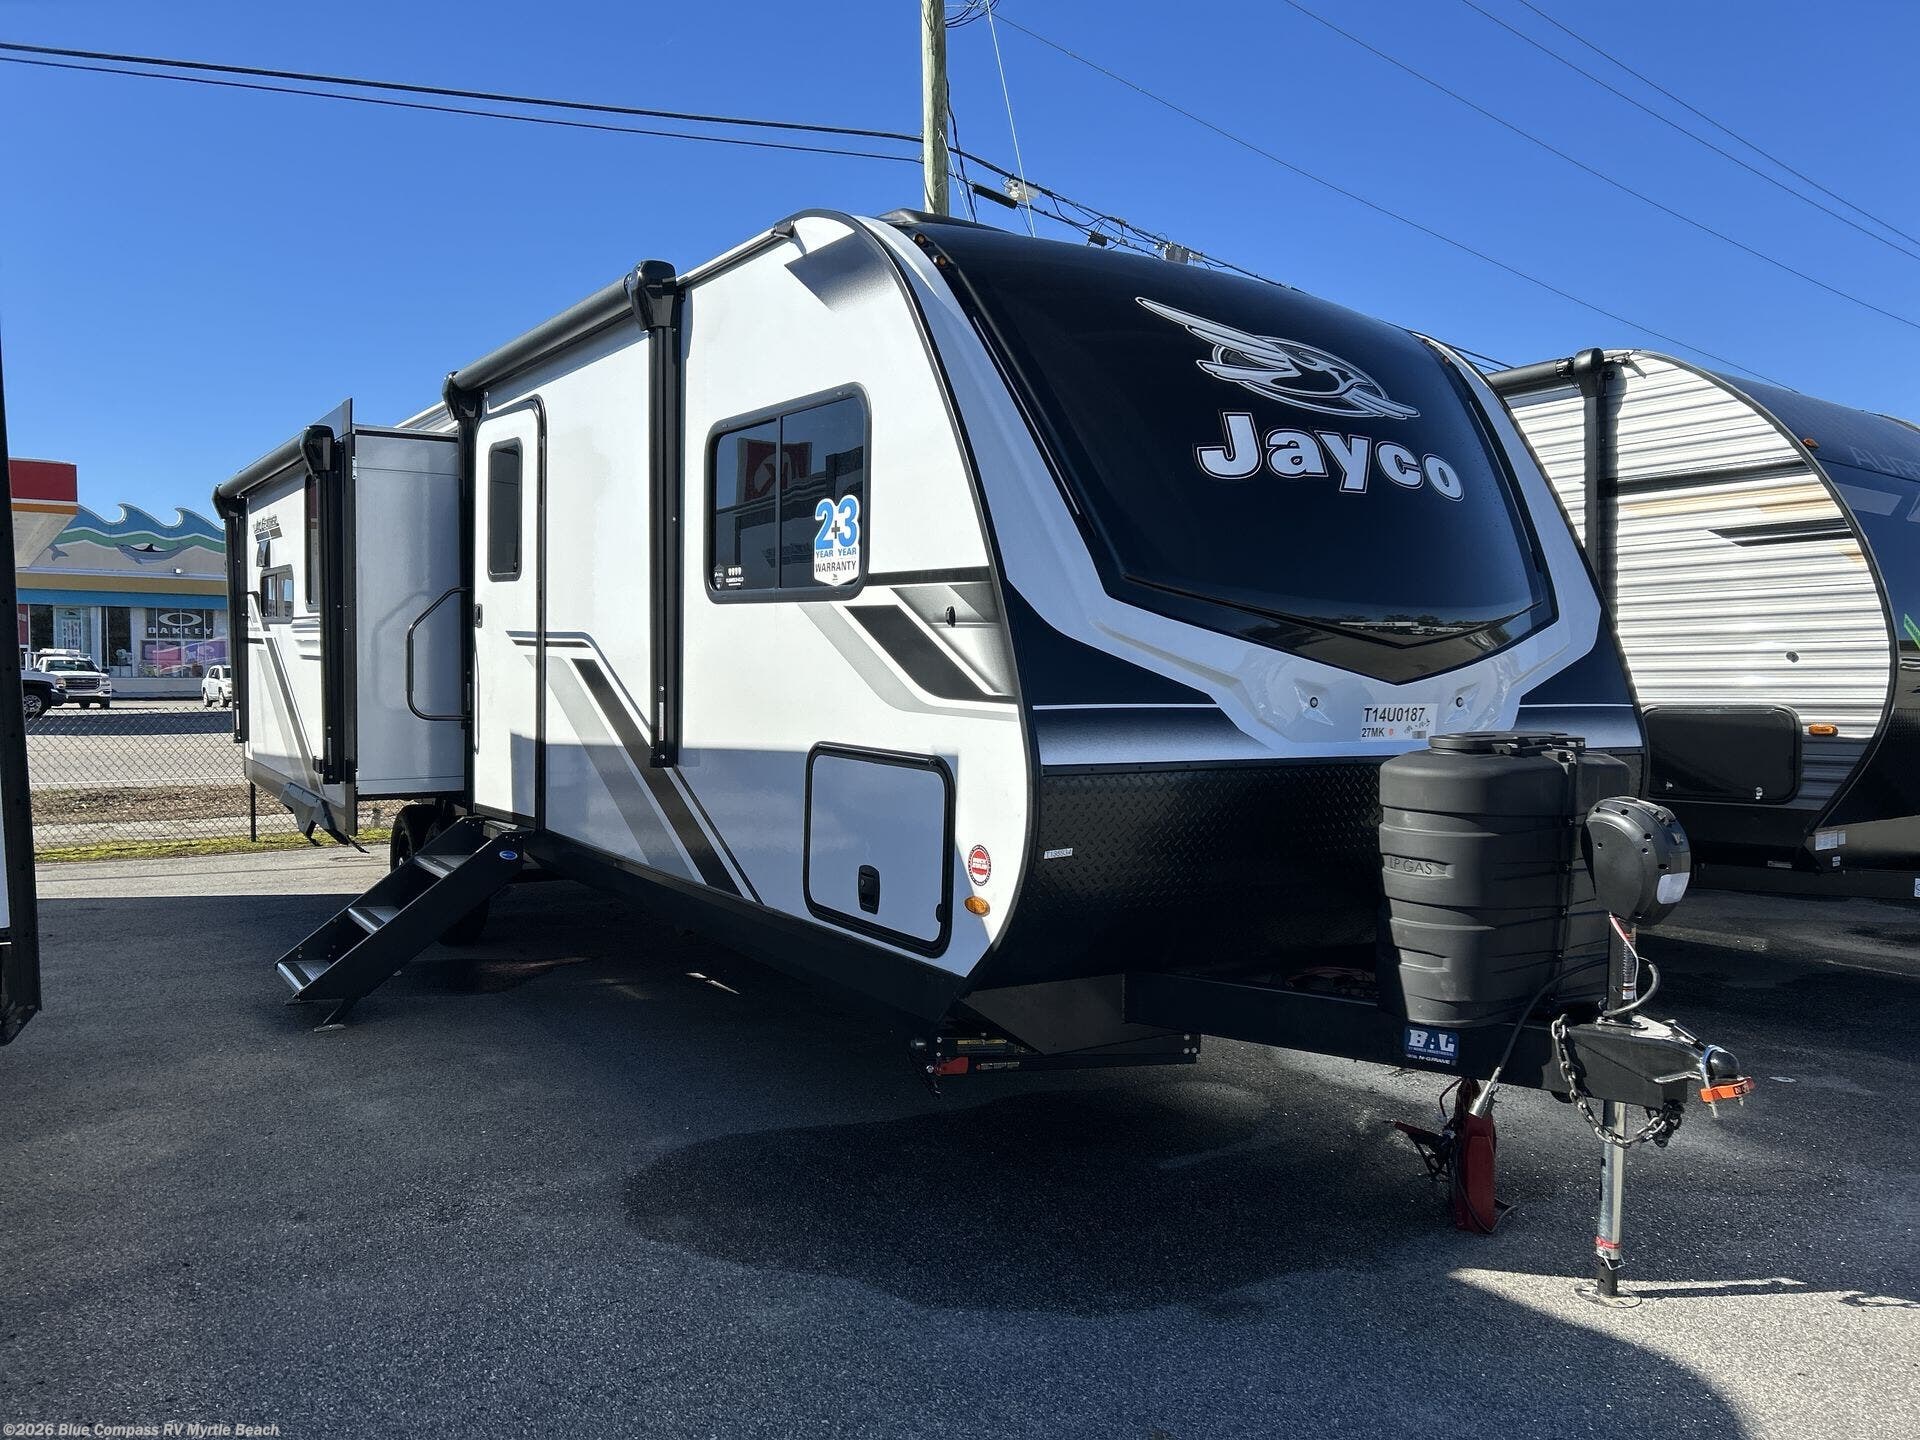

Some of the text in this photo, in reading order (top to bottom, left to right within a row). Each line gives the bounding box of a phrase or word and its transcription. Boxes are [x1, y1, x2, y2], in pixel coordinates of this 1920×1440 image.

[1196, 410, 1466, 503] Jayco
[815, 548, 857, 559] YEAR YEAR
[815, 560, 857, 573] WARRANTY
[147, 627, 213, 635] OAKLEY
[1363, 707, 1426, 723] T14U0187
[1361, 727, 1385, 738] 27MK
[1403, 859, 1433, 875] GAS
